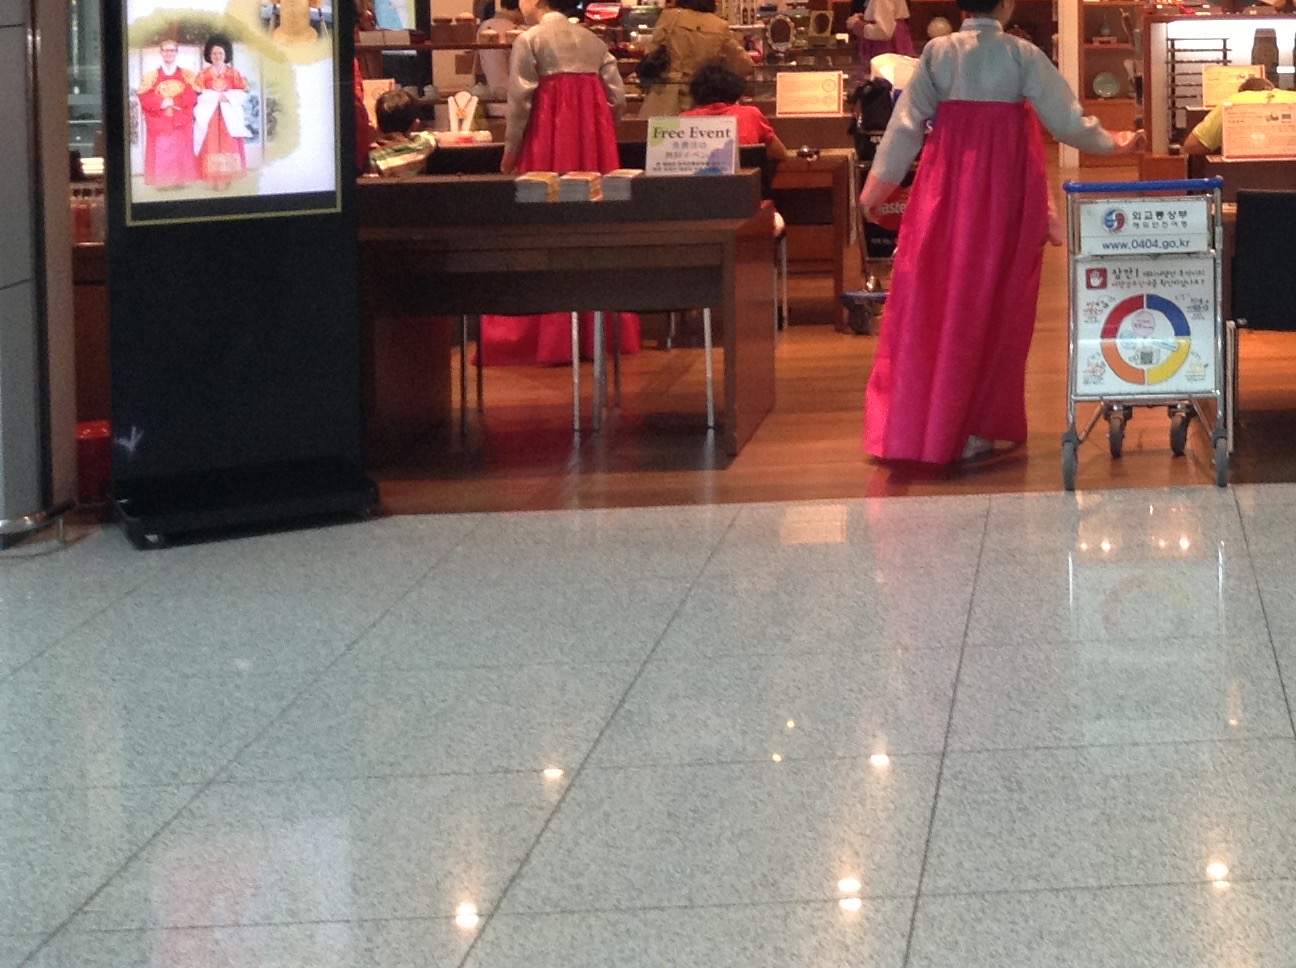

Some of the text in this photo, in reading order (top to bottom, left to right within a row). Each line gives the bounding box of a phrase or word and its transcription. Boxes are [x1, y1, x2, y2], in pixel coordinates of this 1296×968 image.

[653, 126, 731, 139] Free Event
[1102, 238, 1190, 250] www.0404.go.kr
